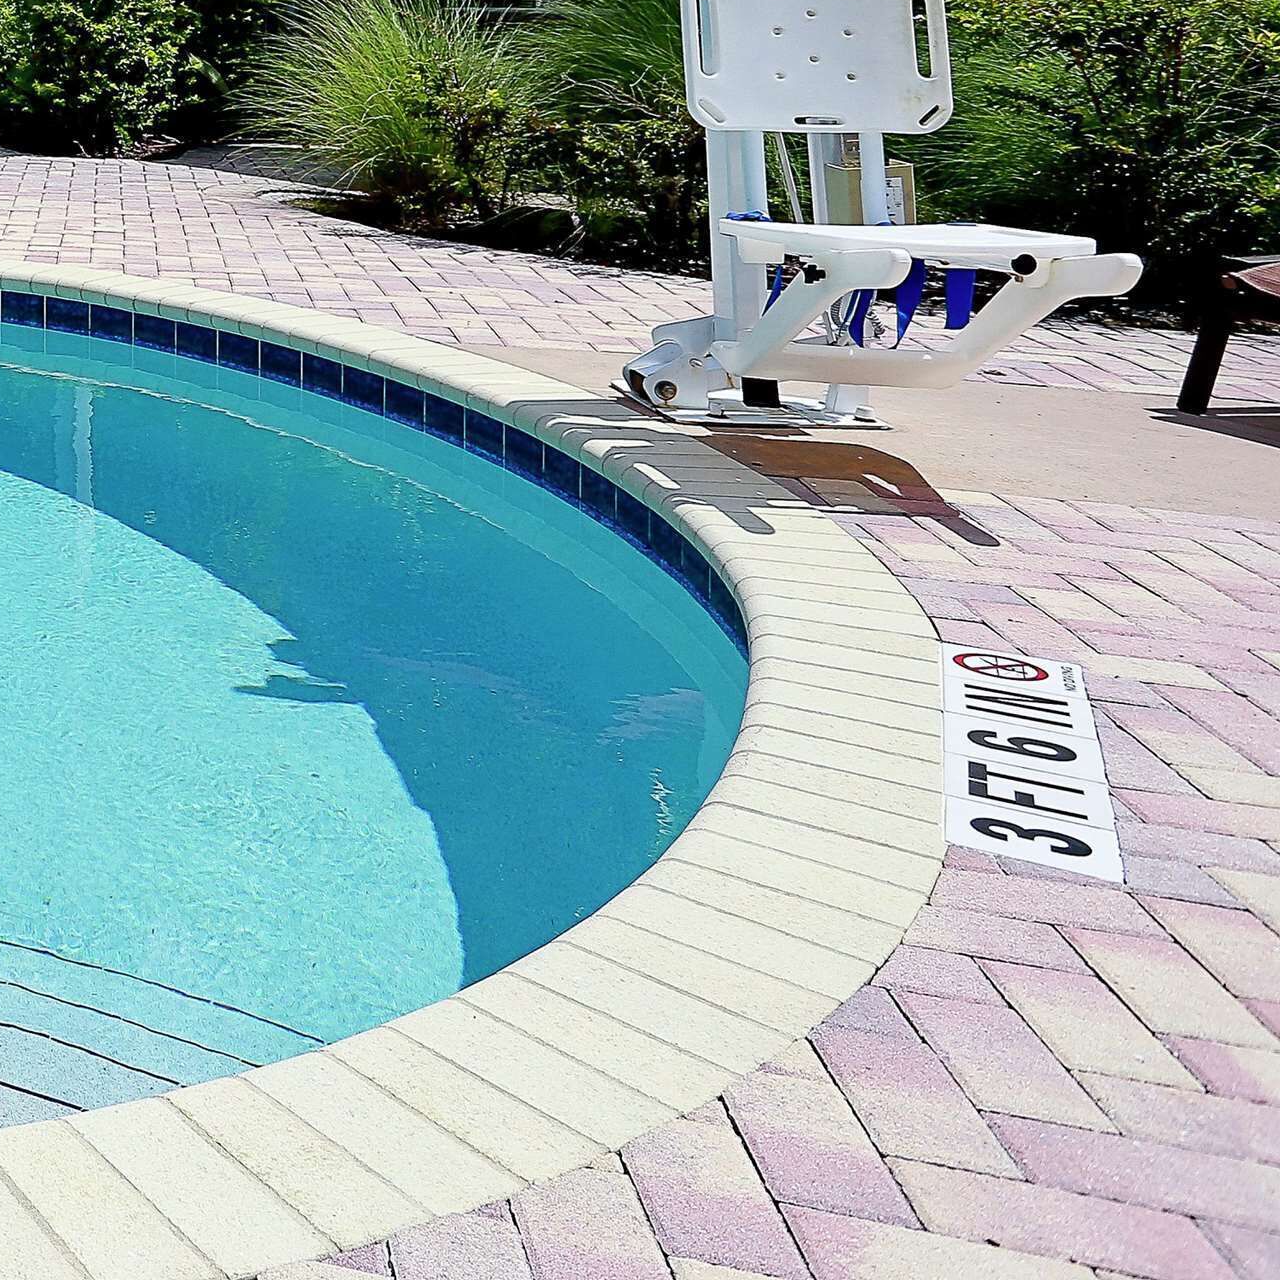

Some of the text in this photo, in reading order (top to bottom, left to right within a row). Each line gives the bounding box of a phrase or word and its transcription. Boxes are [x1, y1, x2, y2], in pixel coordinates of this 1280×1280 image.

[963, 683, 1093, 858] 3 FT 6 IN
